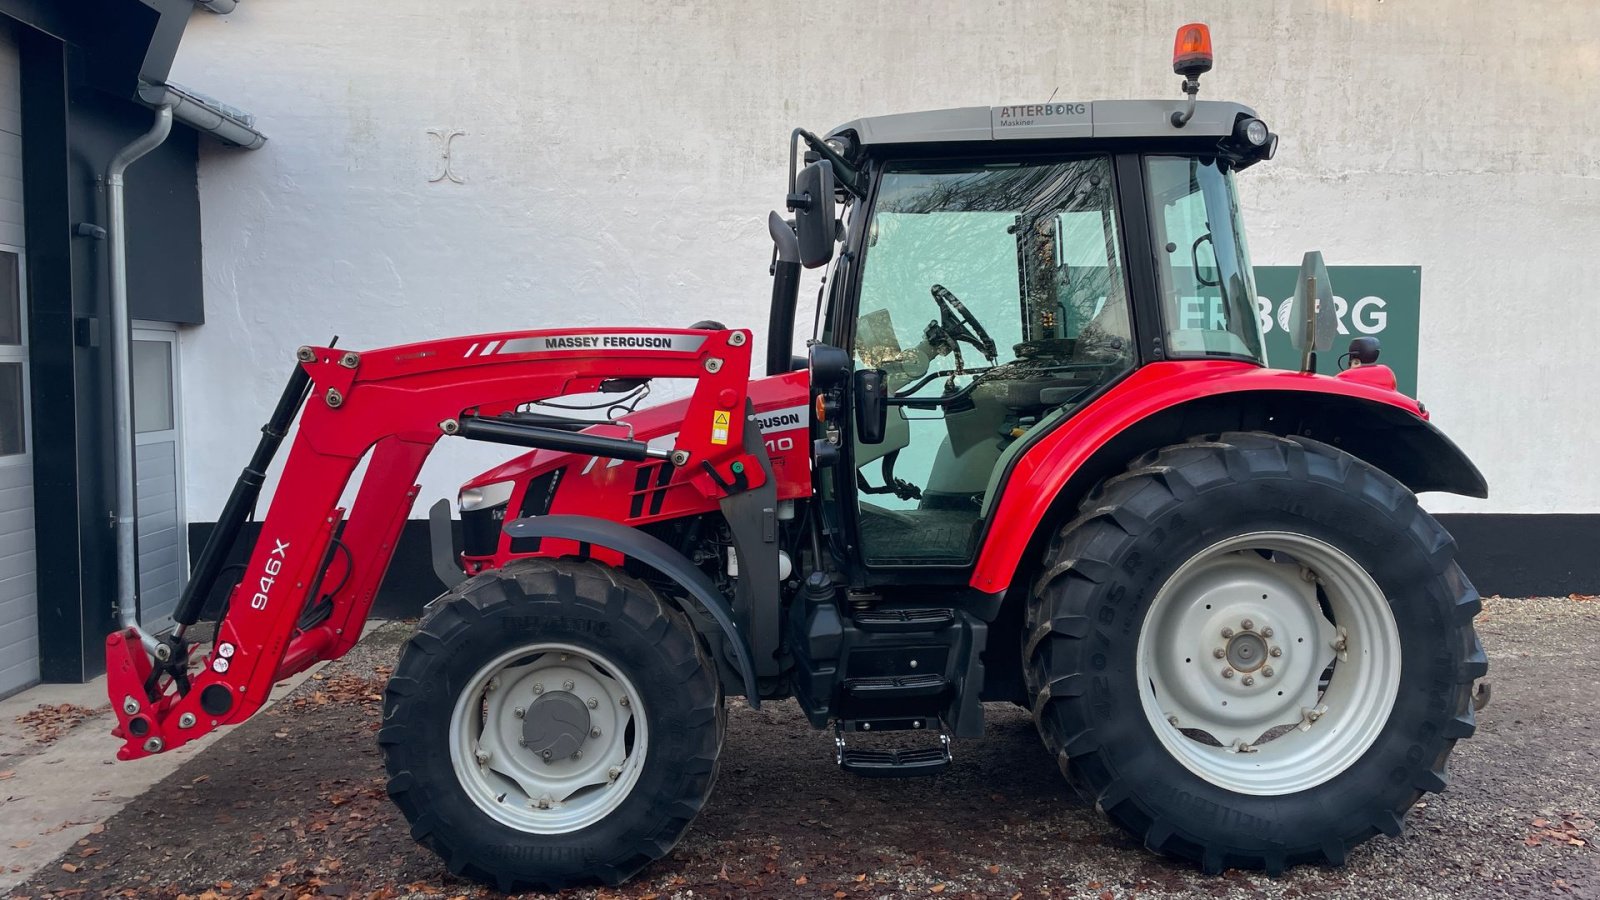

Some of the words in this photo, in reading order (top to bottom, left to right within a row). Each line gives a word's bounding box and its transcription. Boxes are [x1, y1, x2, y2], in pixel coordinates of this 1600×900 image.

[1000, 103, 1086, 118] ATTERBORG
[1000, 119, 1034, 127] Maskiner
[545, 337, 598, 349] MASSEY
[603, 336, 672, 349] FERGUSON
[251, 538, 290, 611] 946X
